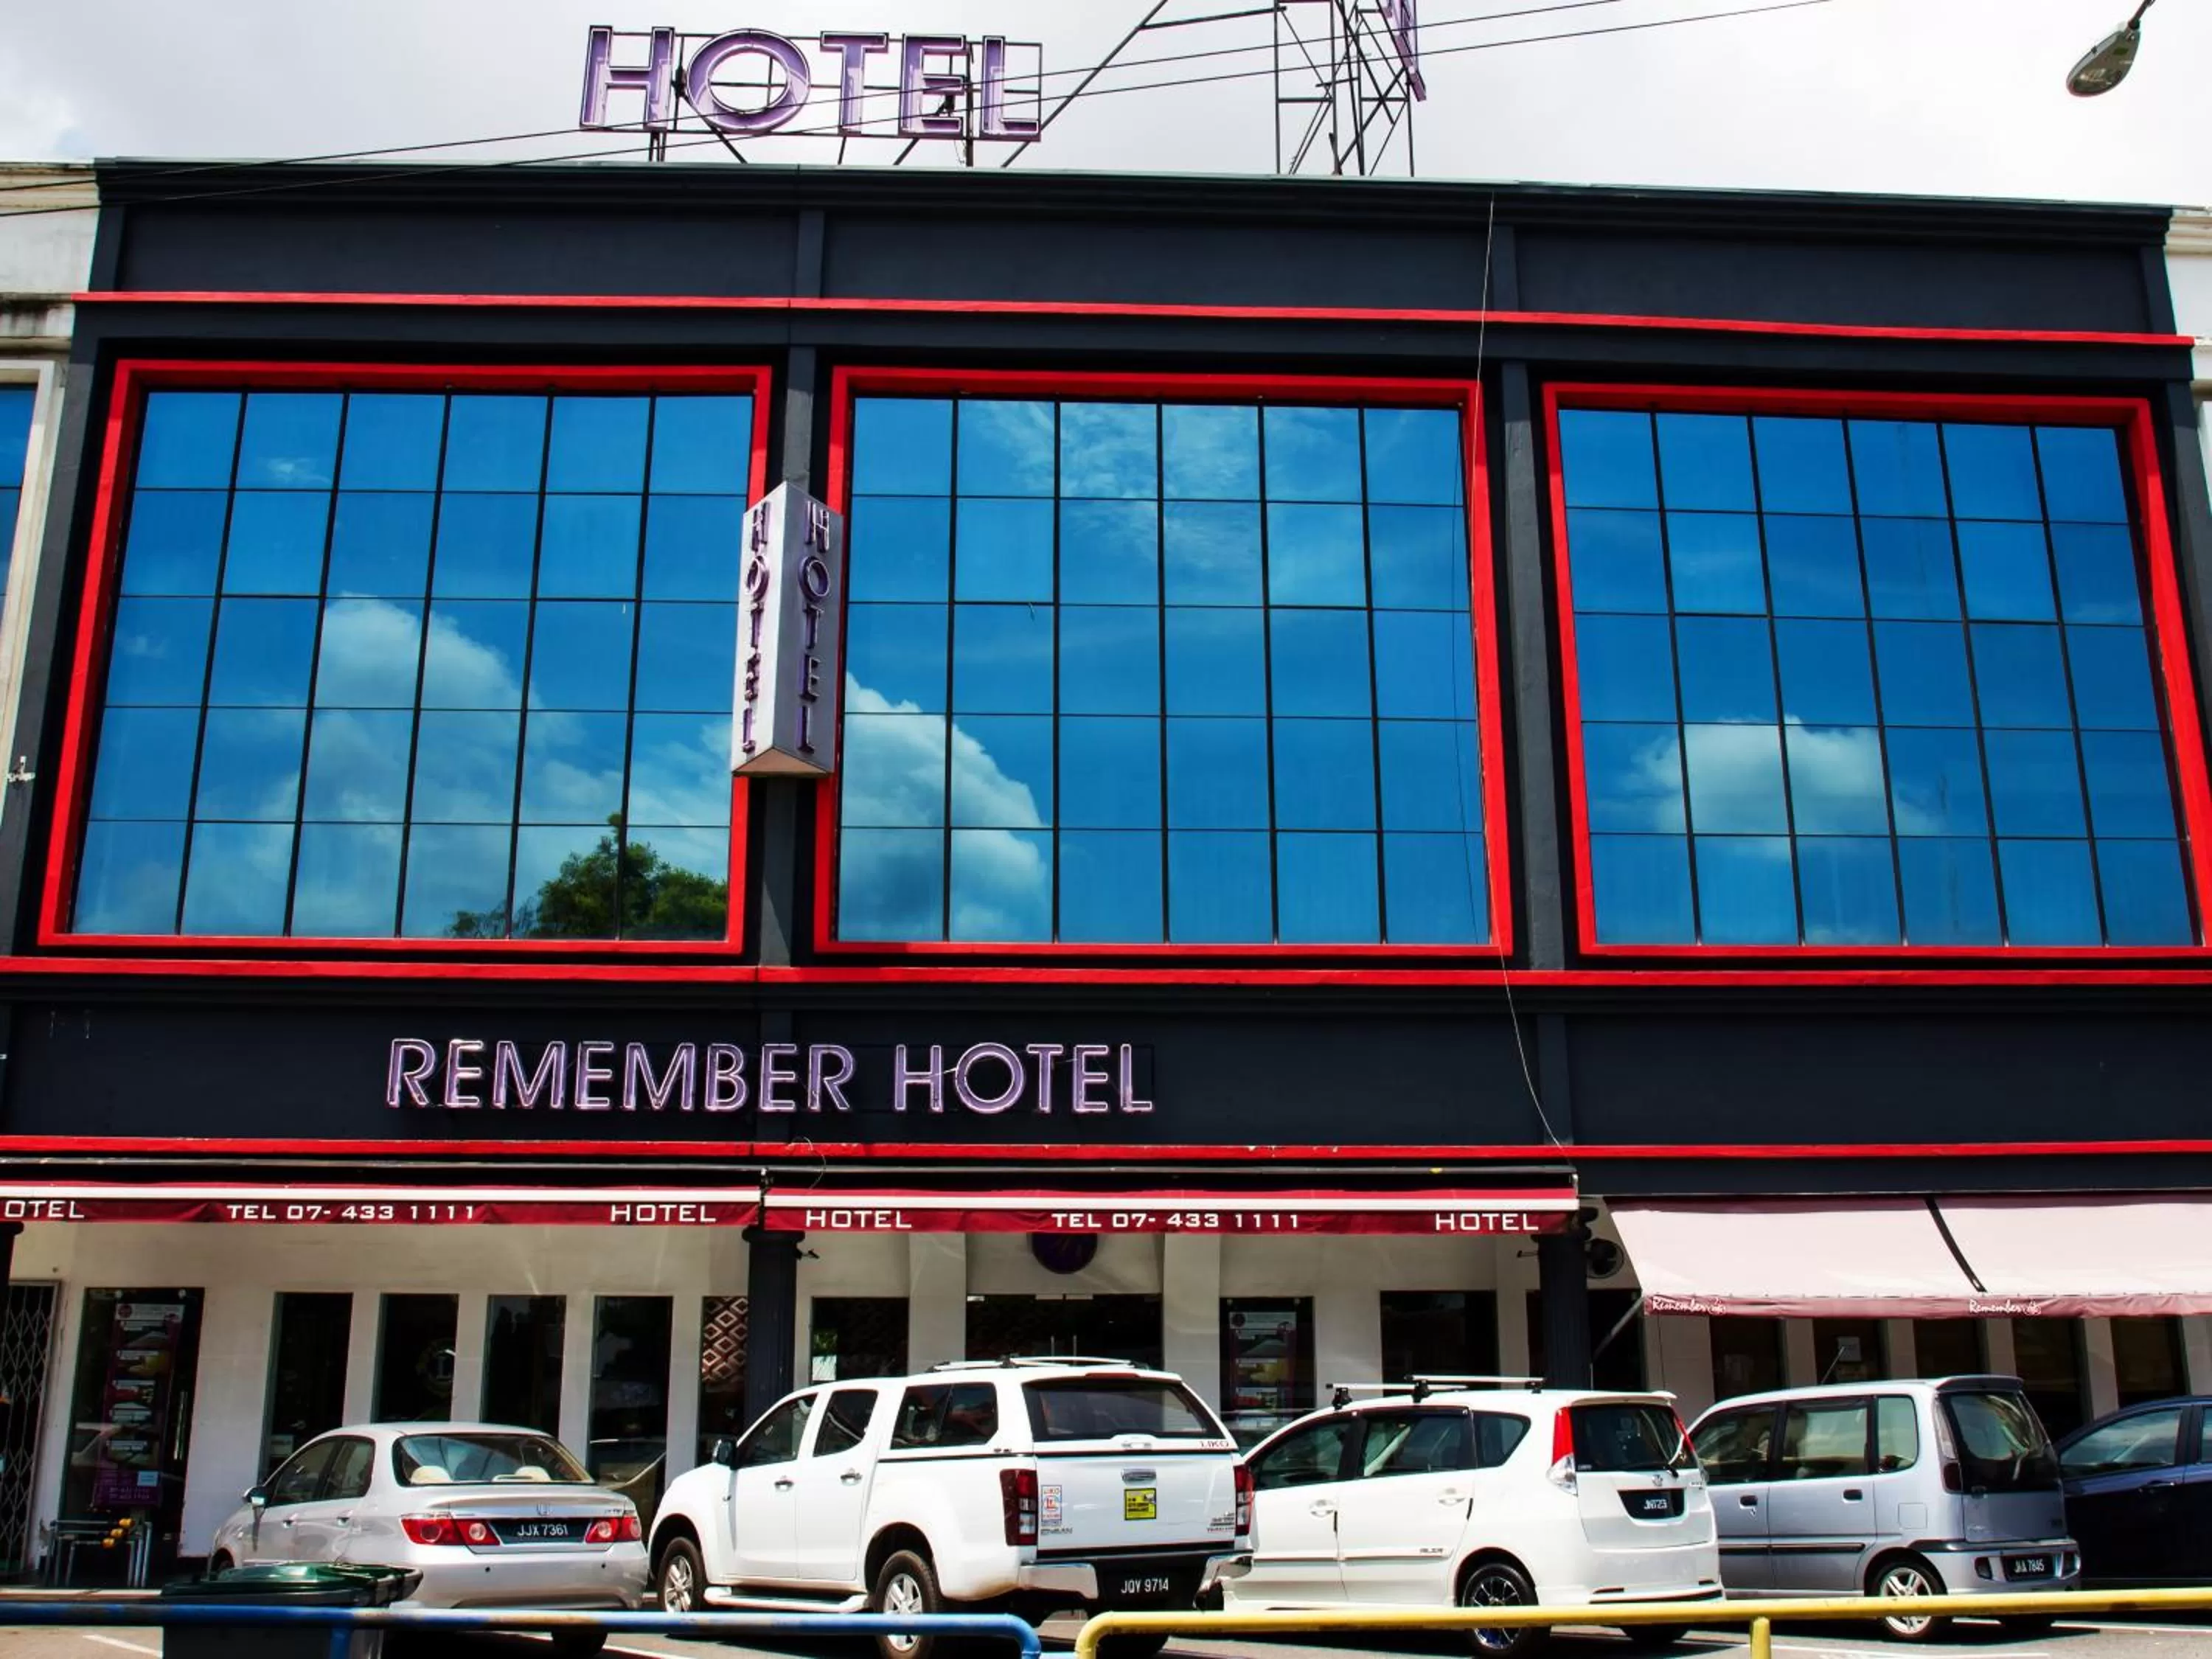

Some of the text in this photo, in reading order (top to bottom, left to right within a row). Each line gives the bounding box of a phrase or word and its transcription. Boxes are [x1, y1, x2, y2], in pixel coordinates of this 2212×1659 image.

[580, 25, 1041, 141] HOTEL
[742, 501, 771, 754] HOTEL
[796, 501, 830, 754] HOTEL
[386, 1037, 1154, 1114] REMEMBER HOTEL
[4, 1200, 85, 1219] OTEL
[226, 1205, 276, 1220] TEL
[341, 1205, 394, 1220] 433
[411, 1205, 474, 1220] 1111
[610, 1204, 717, 1224] HOTEL
[806, 1210, 912, 1228] HOTEL
[1051, 1213, 1102, 1228] TEL
[1166, 1213, 1219, 1228] 433
[1235, 1213, 1298, 1228] 1111
[1435, 1213, 1539, 1231] HOTEL
[1652, 1295, 1708, 1312] Remember
[1969, 1298, 2024, 1313] Remember
[517, 1523, 568, 1537] JJX 7361
[1144, 1578, 1169, 1593] 9714
